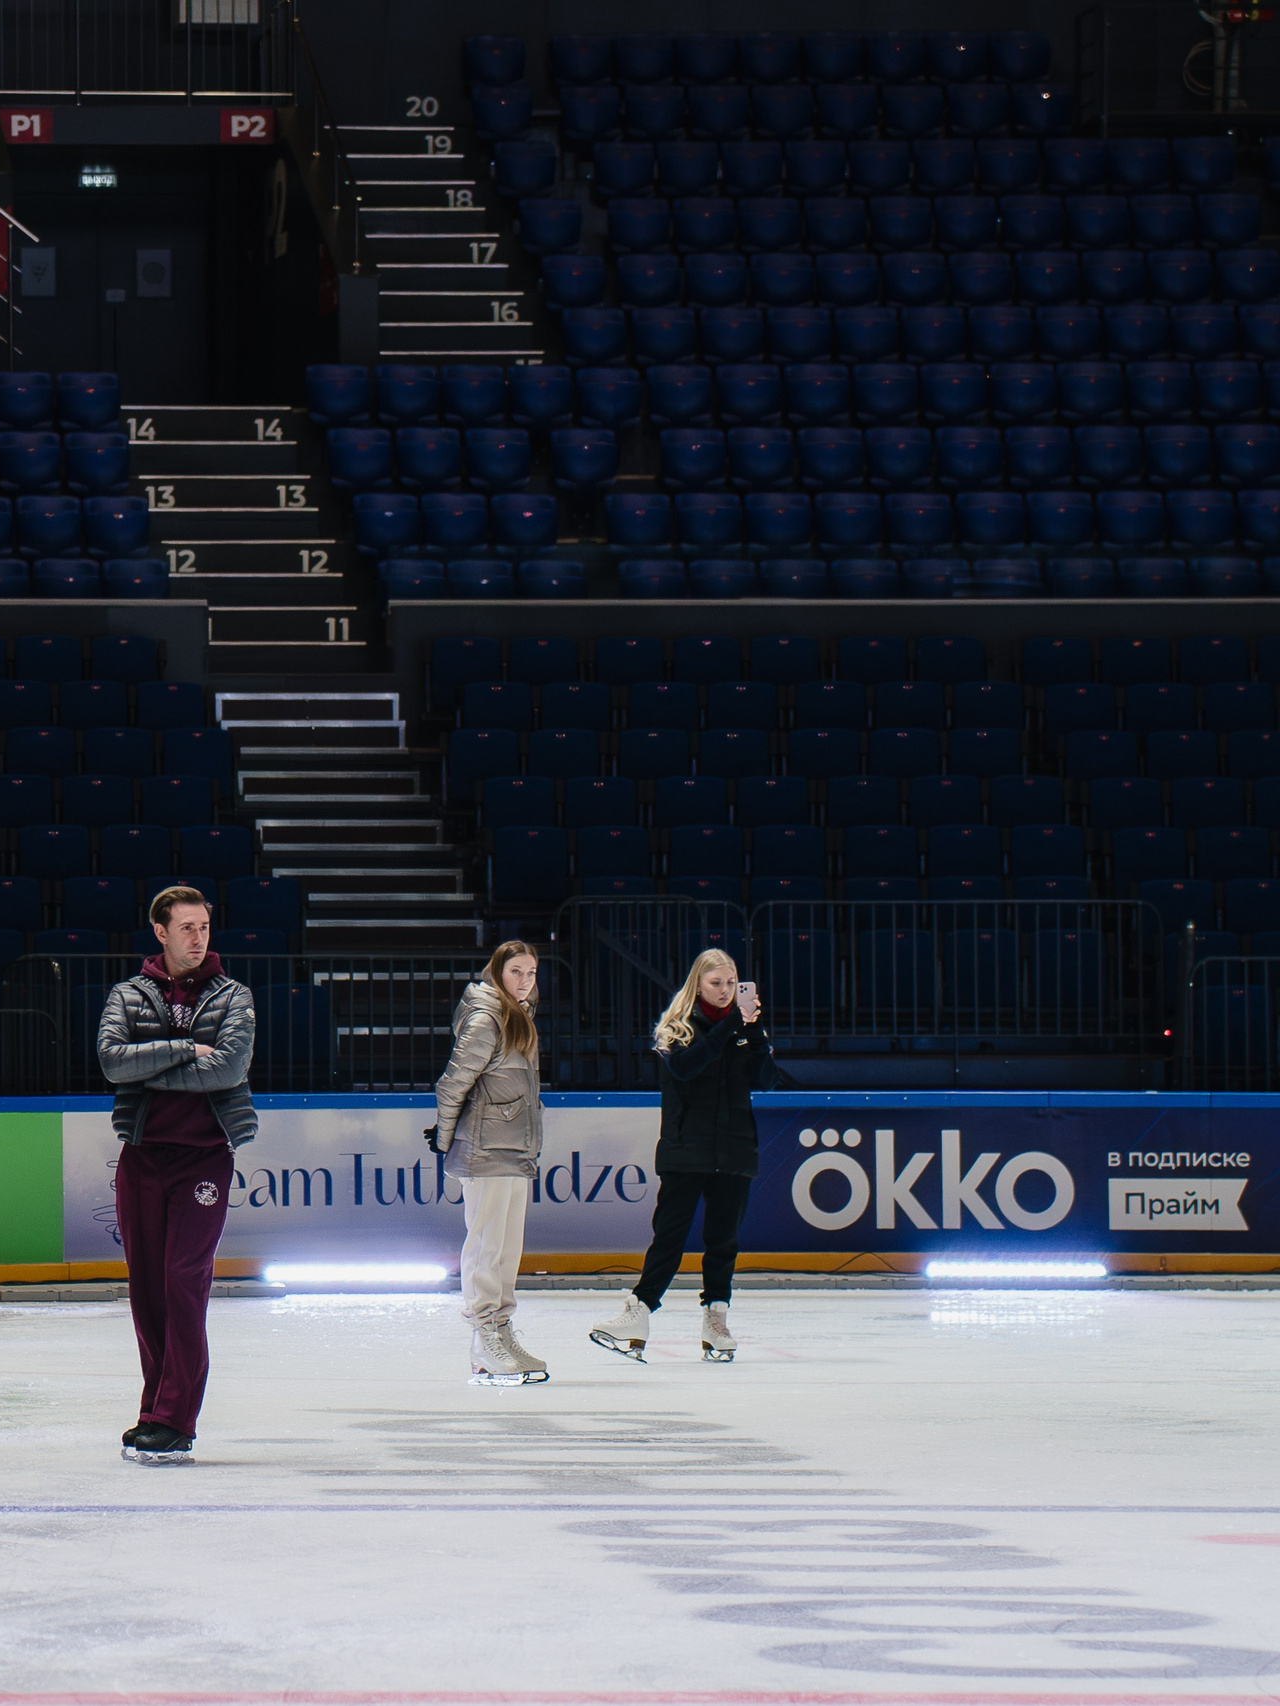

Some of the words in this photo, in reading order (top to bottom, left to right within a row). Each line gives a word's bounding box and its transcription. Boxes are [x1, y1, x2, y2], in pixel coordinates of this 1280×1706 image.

[406, 96, 439, 117] 20
[10, 114, 41, 137] P1
[230, 115, 267, 138] P2
[424, 135, 452, 154] 19
[445, 189, 473, 207] 18
[469, 242, 497, 264] 17
[490, 301, 519, 322] 16
[127, 418, 156, 441] 14
[254, 418, 283, 441] 14
[145, 486, 176, 508] 13
[276, 485, 307, 508] 13
[166, 549, 196, 573] 12
[299, 549, 329, 573] 12
[325, 617, 350, 642] 11
[1108, 1153, 1121, 1168] в
[1128, 1151, 1251, 1170] подписке
[229, 1168, 333, 1208] eam
[339, 1151, 648, 1206] Tutbidze
[1124, 1191, 1221, 1220] Прайм
